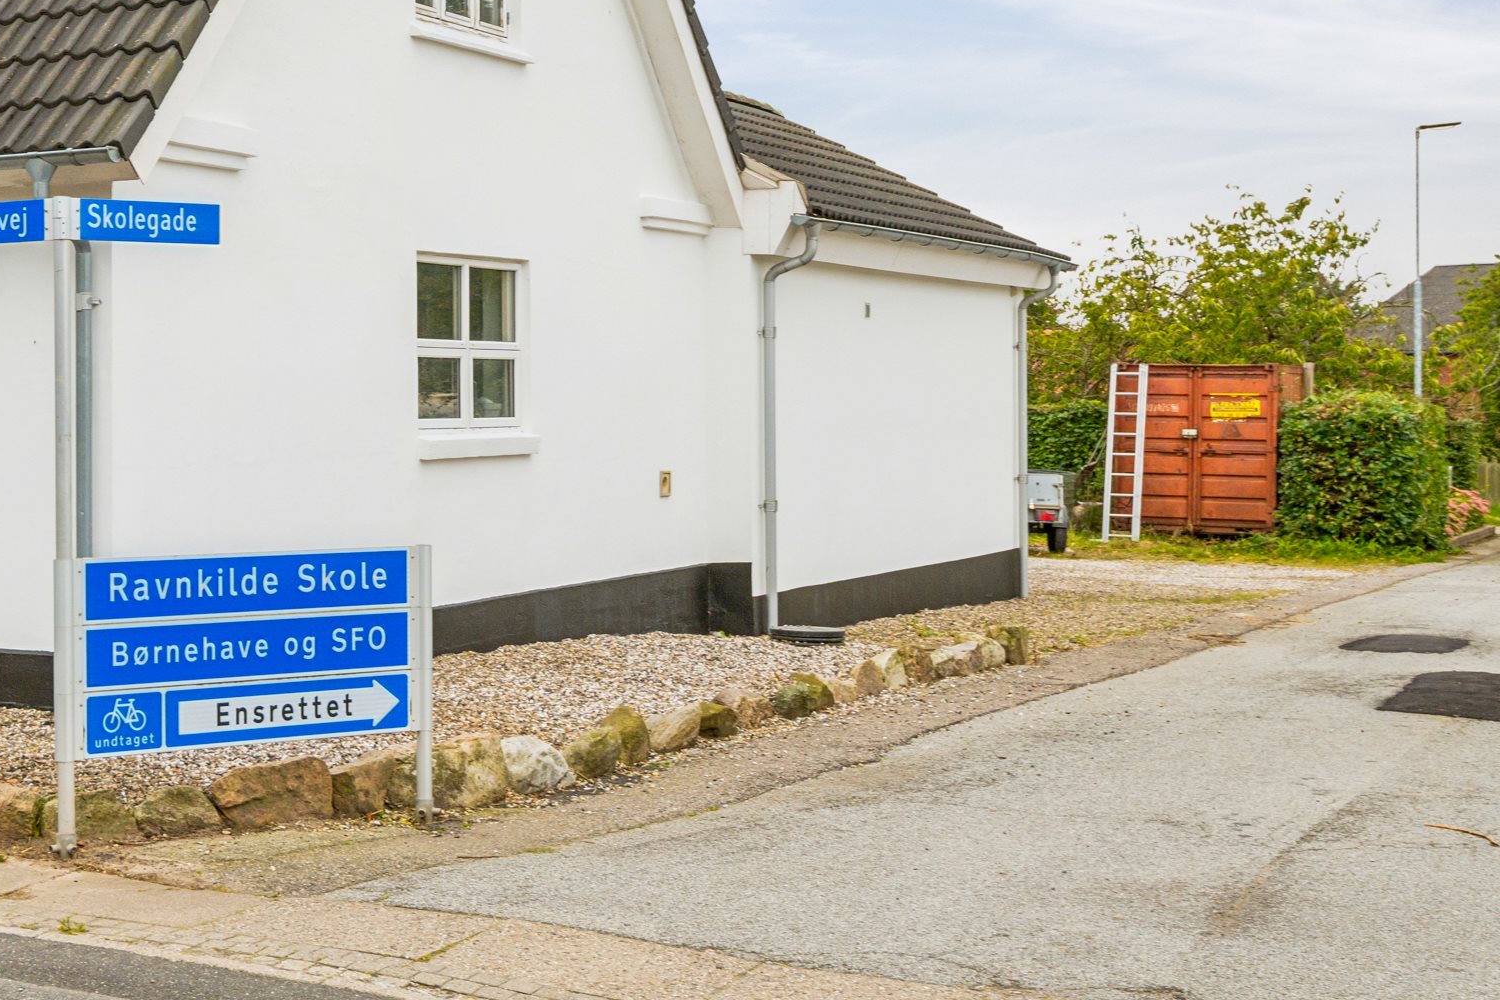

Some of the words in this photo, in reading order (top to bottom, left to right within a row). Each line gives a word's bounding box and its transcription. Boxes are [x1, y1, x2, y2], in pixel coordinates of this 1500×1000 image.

[87, 203, 197, 238] Skolegade
[109, 566, 279, 602] Ravnkilde
[297, 561, 388, 593] Skole
[112, 636, 269, 667] Børnehave
[284, 635, 316, 659] og
[331, 625, 387, 653] SFO
[216, 694, 353, 727] Ensrettet
[94, 732, 155, 748] undtaget
